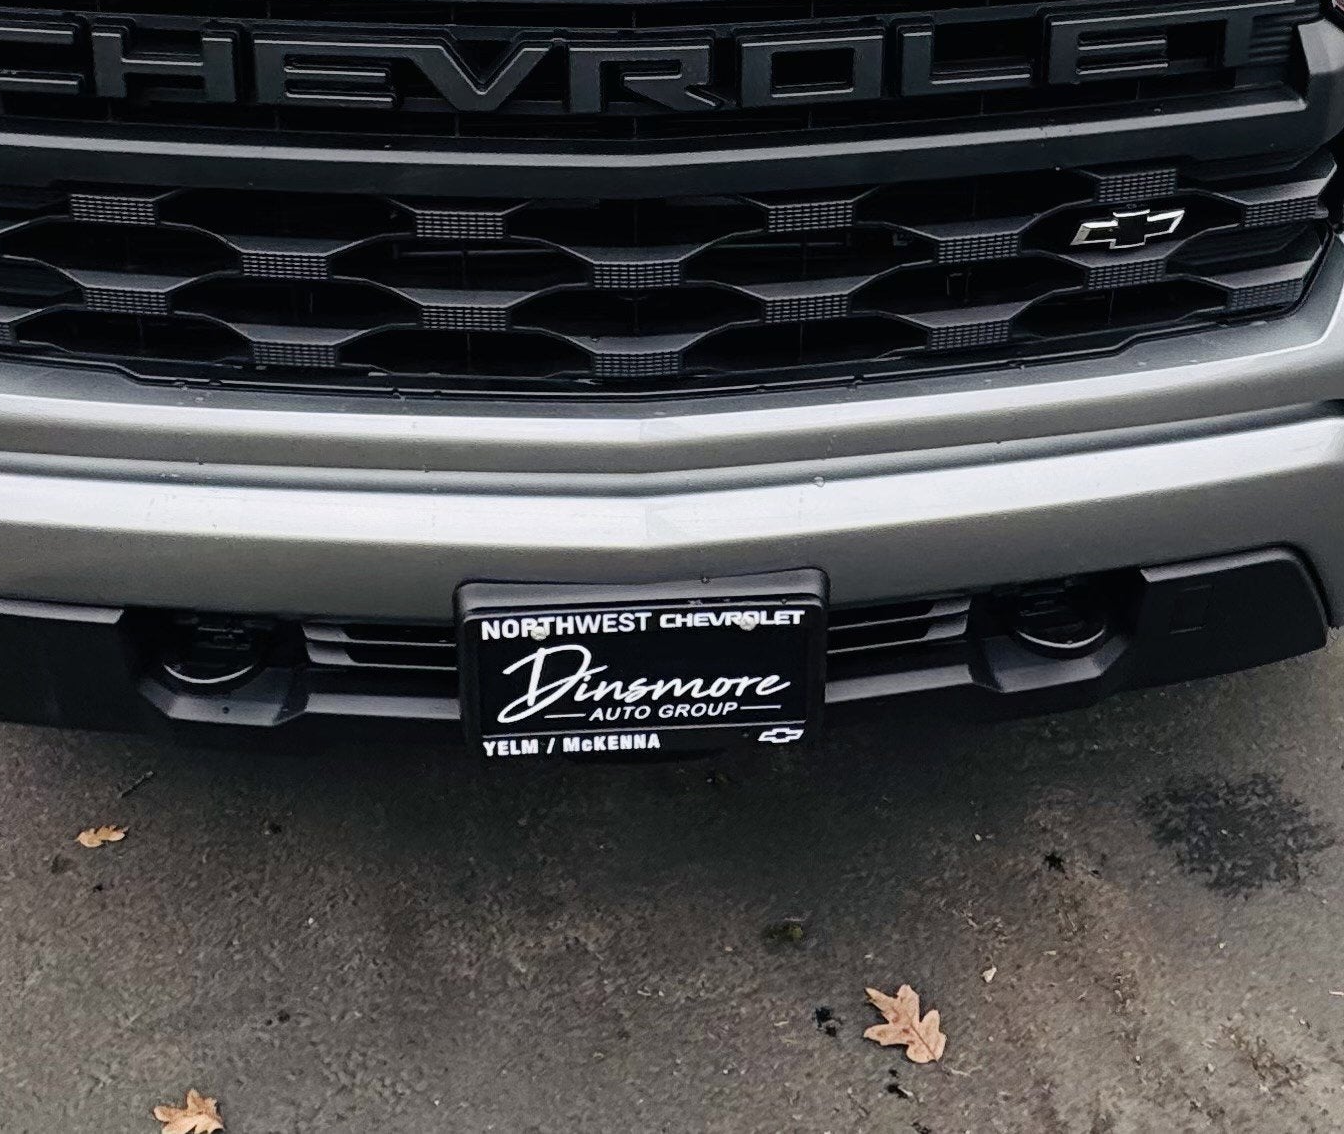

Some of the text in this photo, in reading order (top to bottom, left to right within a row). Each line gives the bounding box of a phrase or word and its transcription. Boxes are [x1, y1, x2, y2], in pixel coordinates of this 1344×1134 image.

[481, 611, 653, 640] NORTHWEST
[496, 643, 792, 724] Dinsmore
[588, 701, 739, 722] AUTO GROUP
[482, 737, 539, 758] YELM
[562, 732, 661, 754] McKENNA
